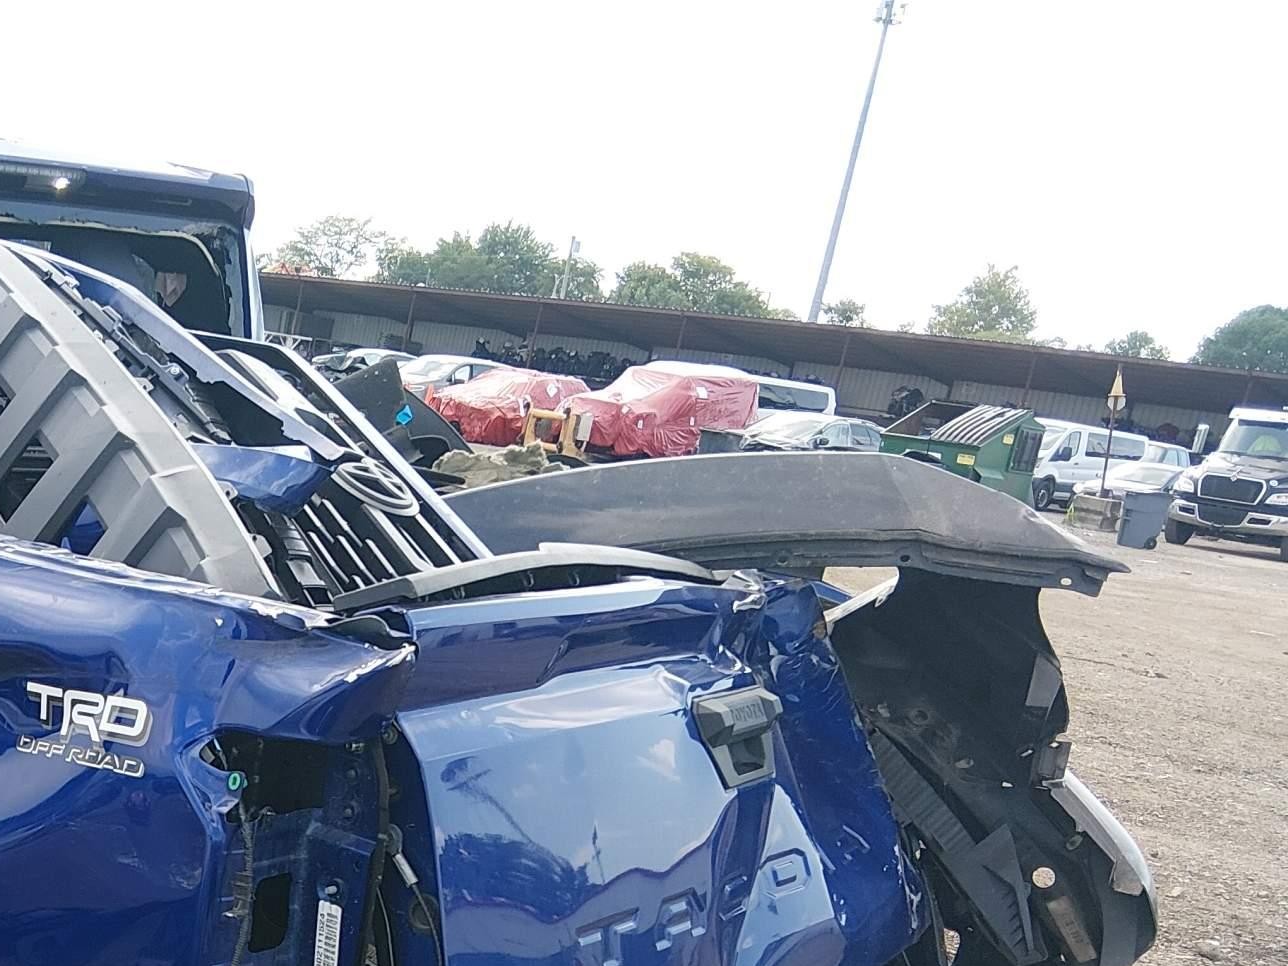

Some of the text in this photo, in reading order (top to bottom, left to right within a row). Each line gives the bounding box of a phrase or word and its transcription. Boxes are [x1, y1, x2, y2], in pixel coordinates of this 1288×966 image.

[26, 681, 153, 746] TRD
[16, 735, 145, 778] OFF ROAD
